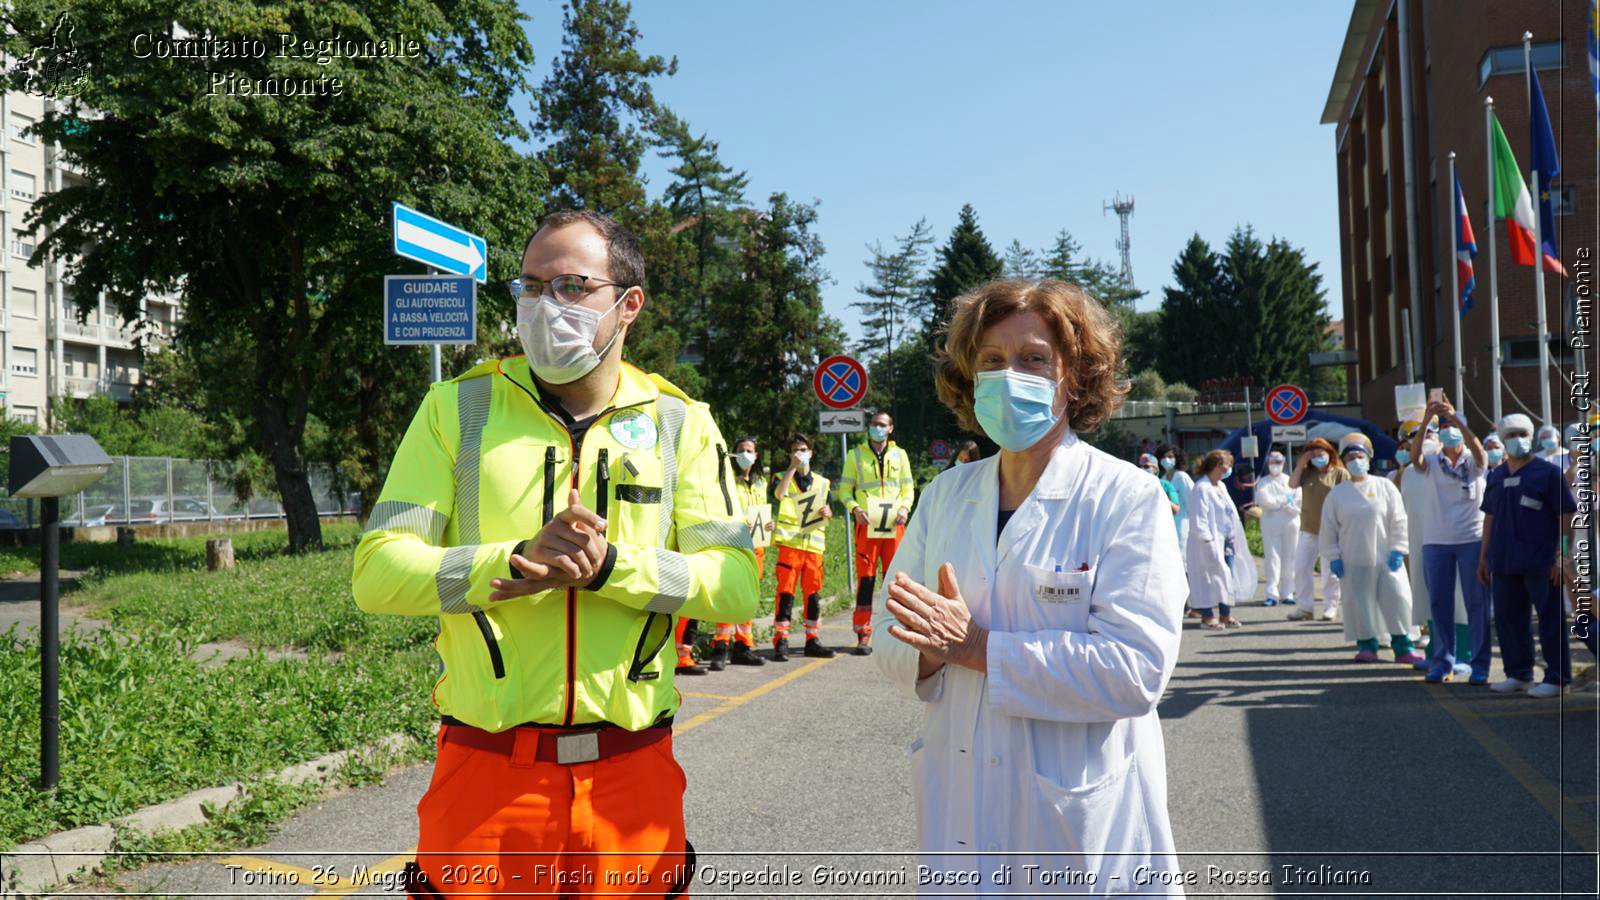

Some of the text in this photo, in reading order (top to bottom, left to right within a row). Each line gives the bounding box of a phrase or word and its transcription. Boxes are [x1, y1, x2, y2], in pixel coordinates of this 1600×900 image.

[404, 282, 458, 293] GUIDARE
[396, 298, 465, 307] GLI AUTOVEICOLI
[392, 310, 469, 323] A BASSA VELOCITÀ
[395, 327, 466, 337] E CON PRUDENZA
[798, 494, 824, 529] Z
[873, 503, 893, 533] I
[751, 511, 765, 541] A
